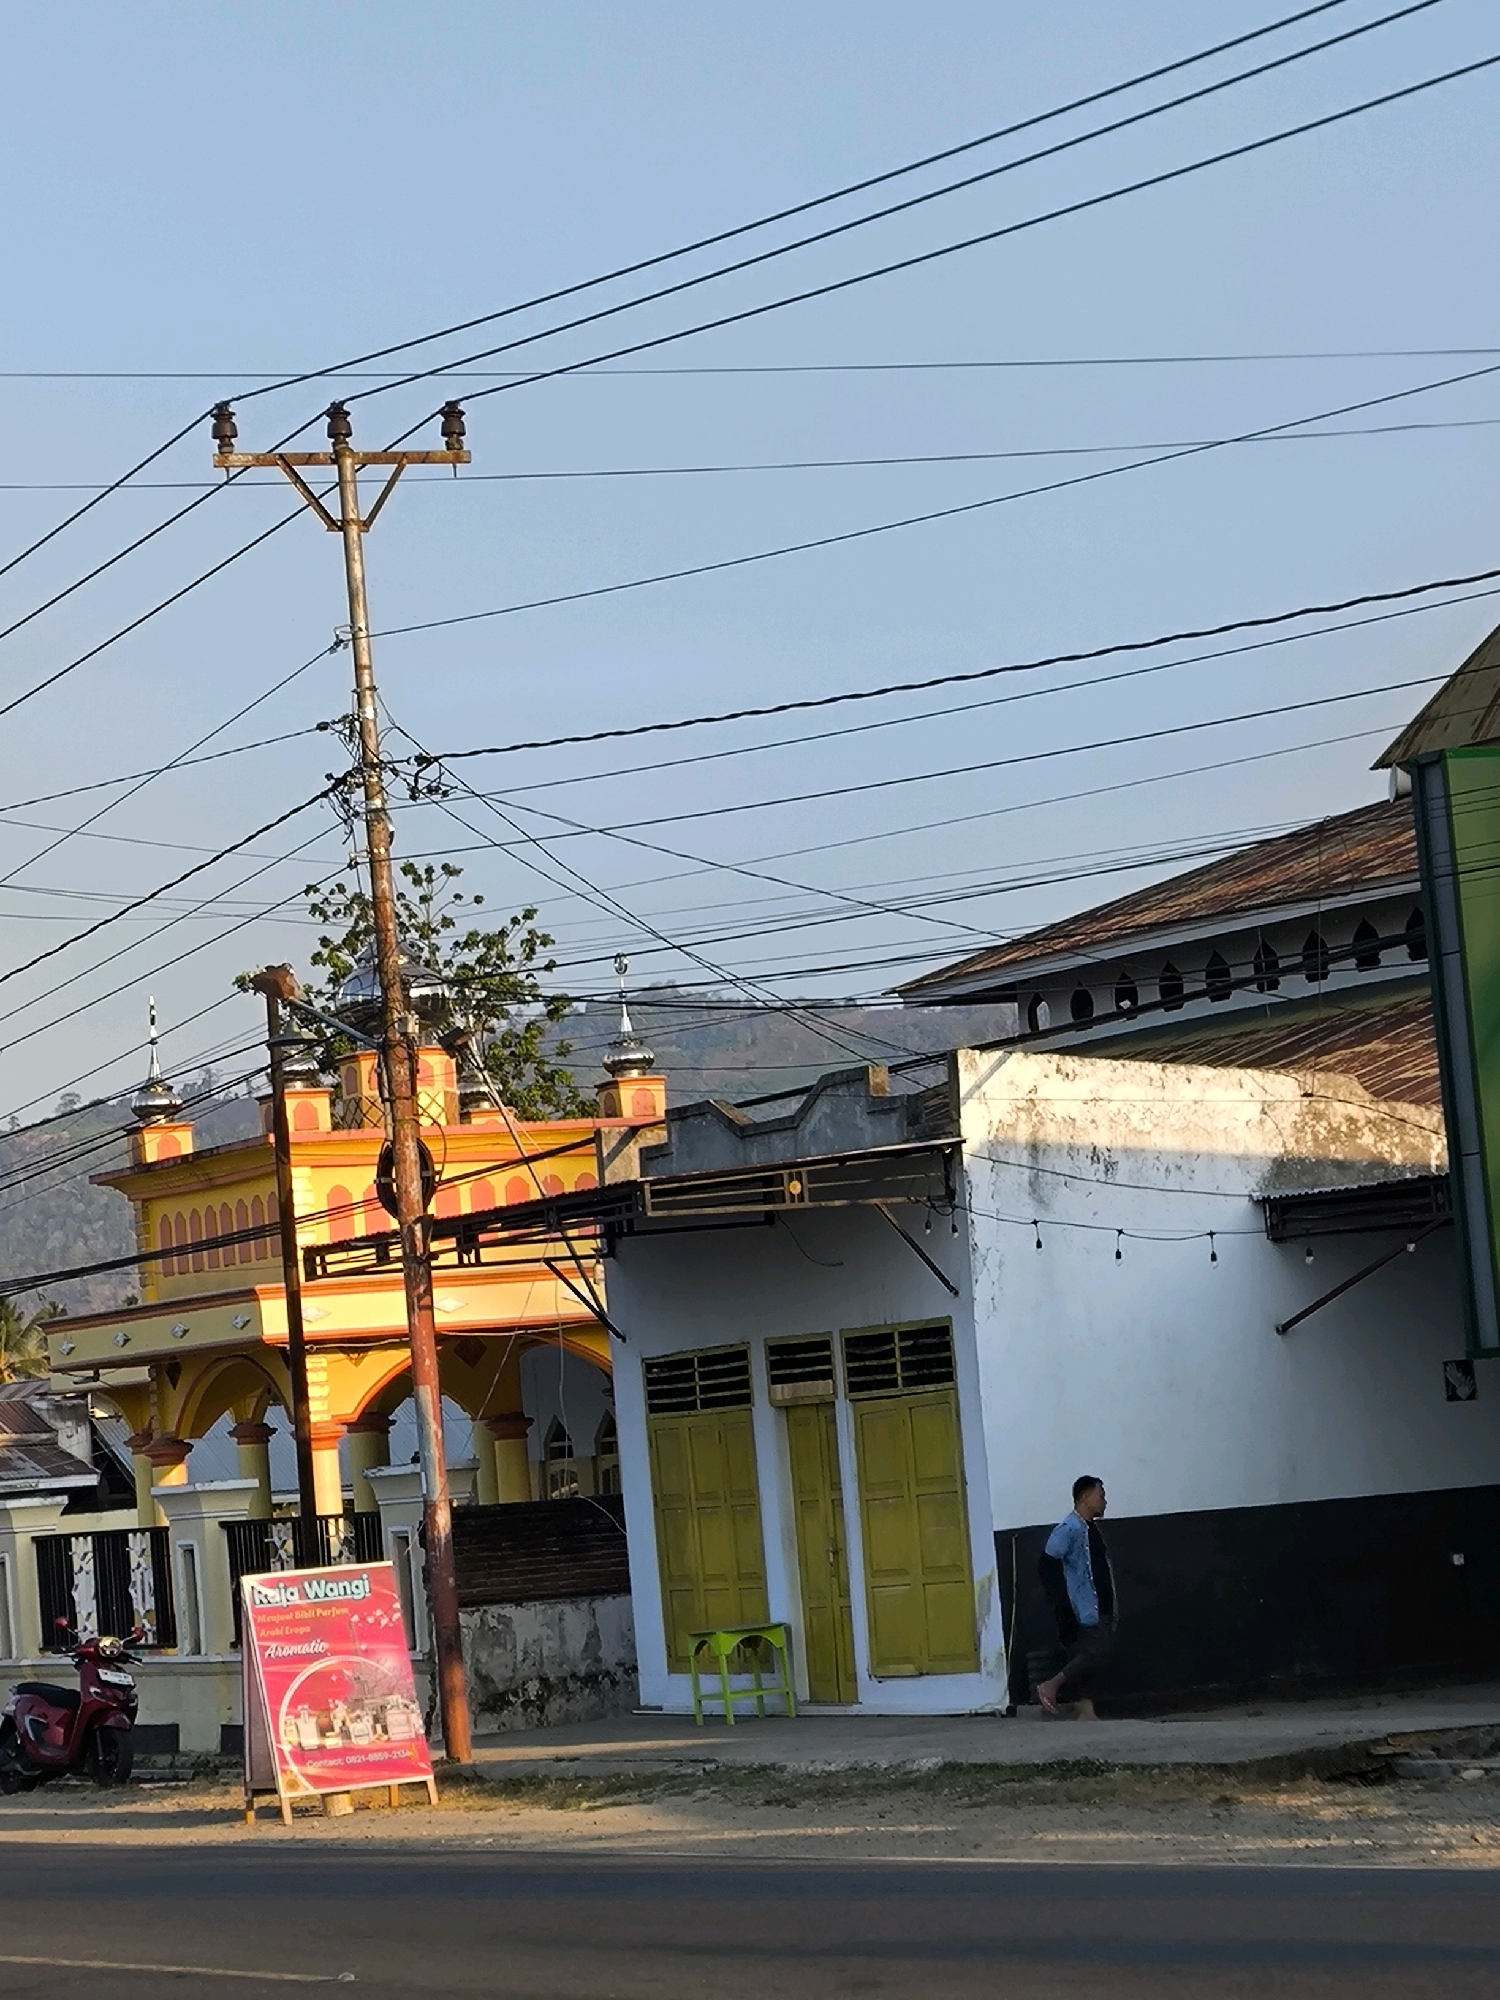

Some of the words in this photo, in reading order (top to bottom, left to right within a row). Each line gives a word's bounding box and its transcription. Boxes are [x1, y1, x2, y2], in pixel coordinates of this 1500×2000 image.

[303, 1573, 371, 1601] Wangi
[316, 1607, 349, 1618] Parfum
[265, 1638, 328, 1659] Aromatic
